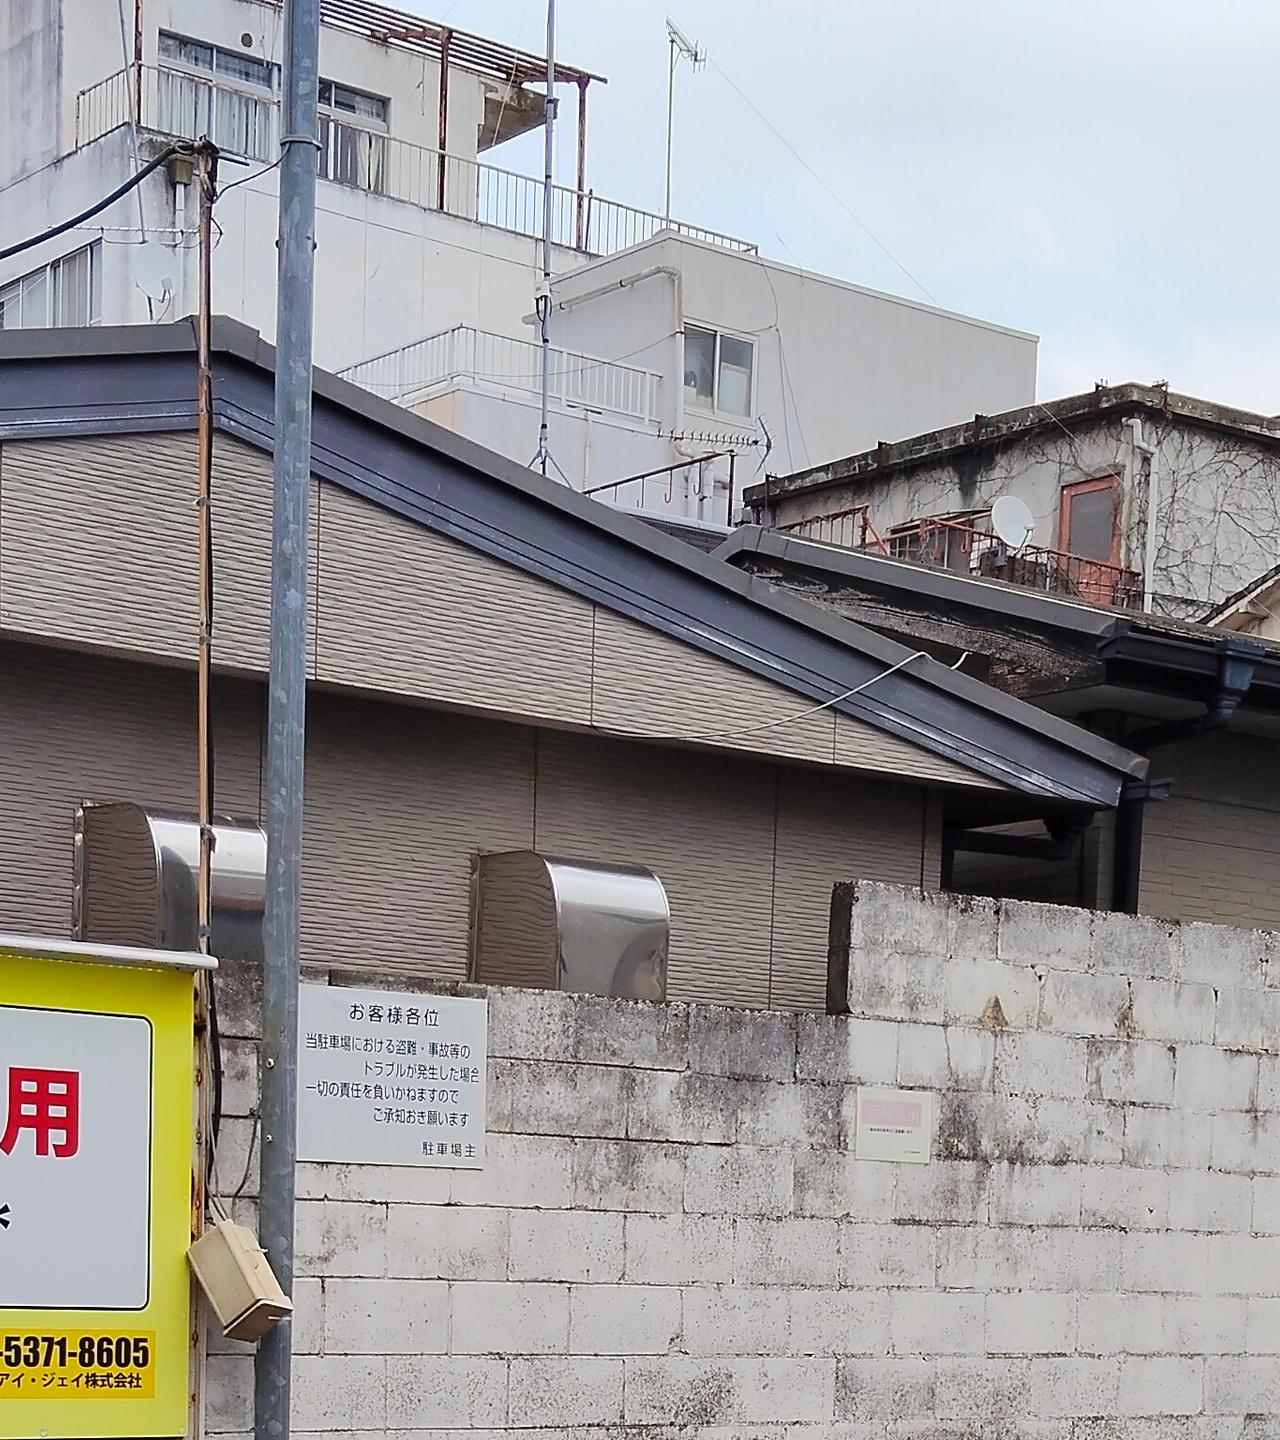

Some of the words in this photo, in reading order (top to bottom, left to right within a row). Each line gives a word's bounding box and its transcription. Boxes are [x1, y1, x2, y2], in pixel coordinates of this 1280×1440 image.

[349, 1003, 439, 1027] お客様各位
[305, 1032, 470, 1059] 当駐車場における盗難・事故等の
[364, 1061, 480, 1083] トラブルが発生した場合
[305, 1080, 459, 1104] 一切の責任を負いかねますので
[373, 1107, 469, 1127] ご承知おき願います
[422, 1141, 476, 1158] 駐車場主
